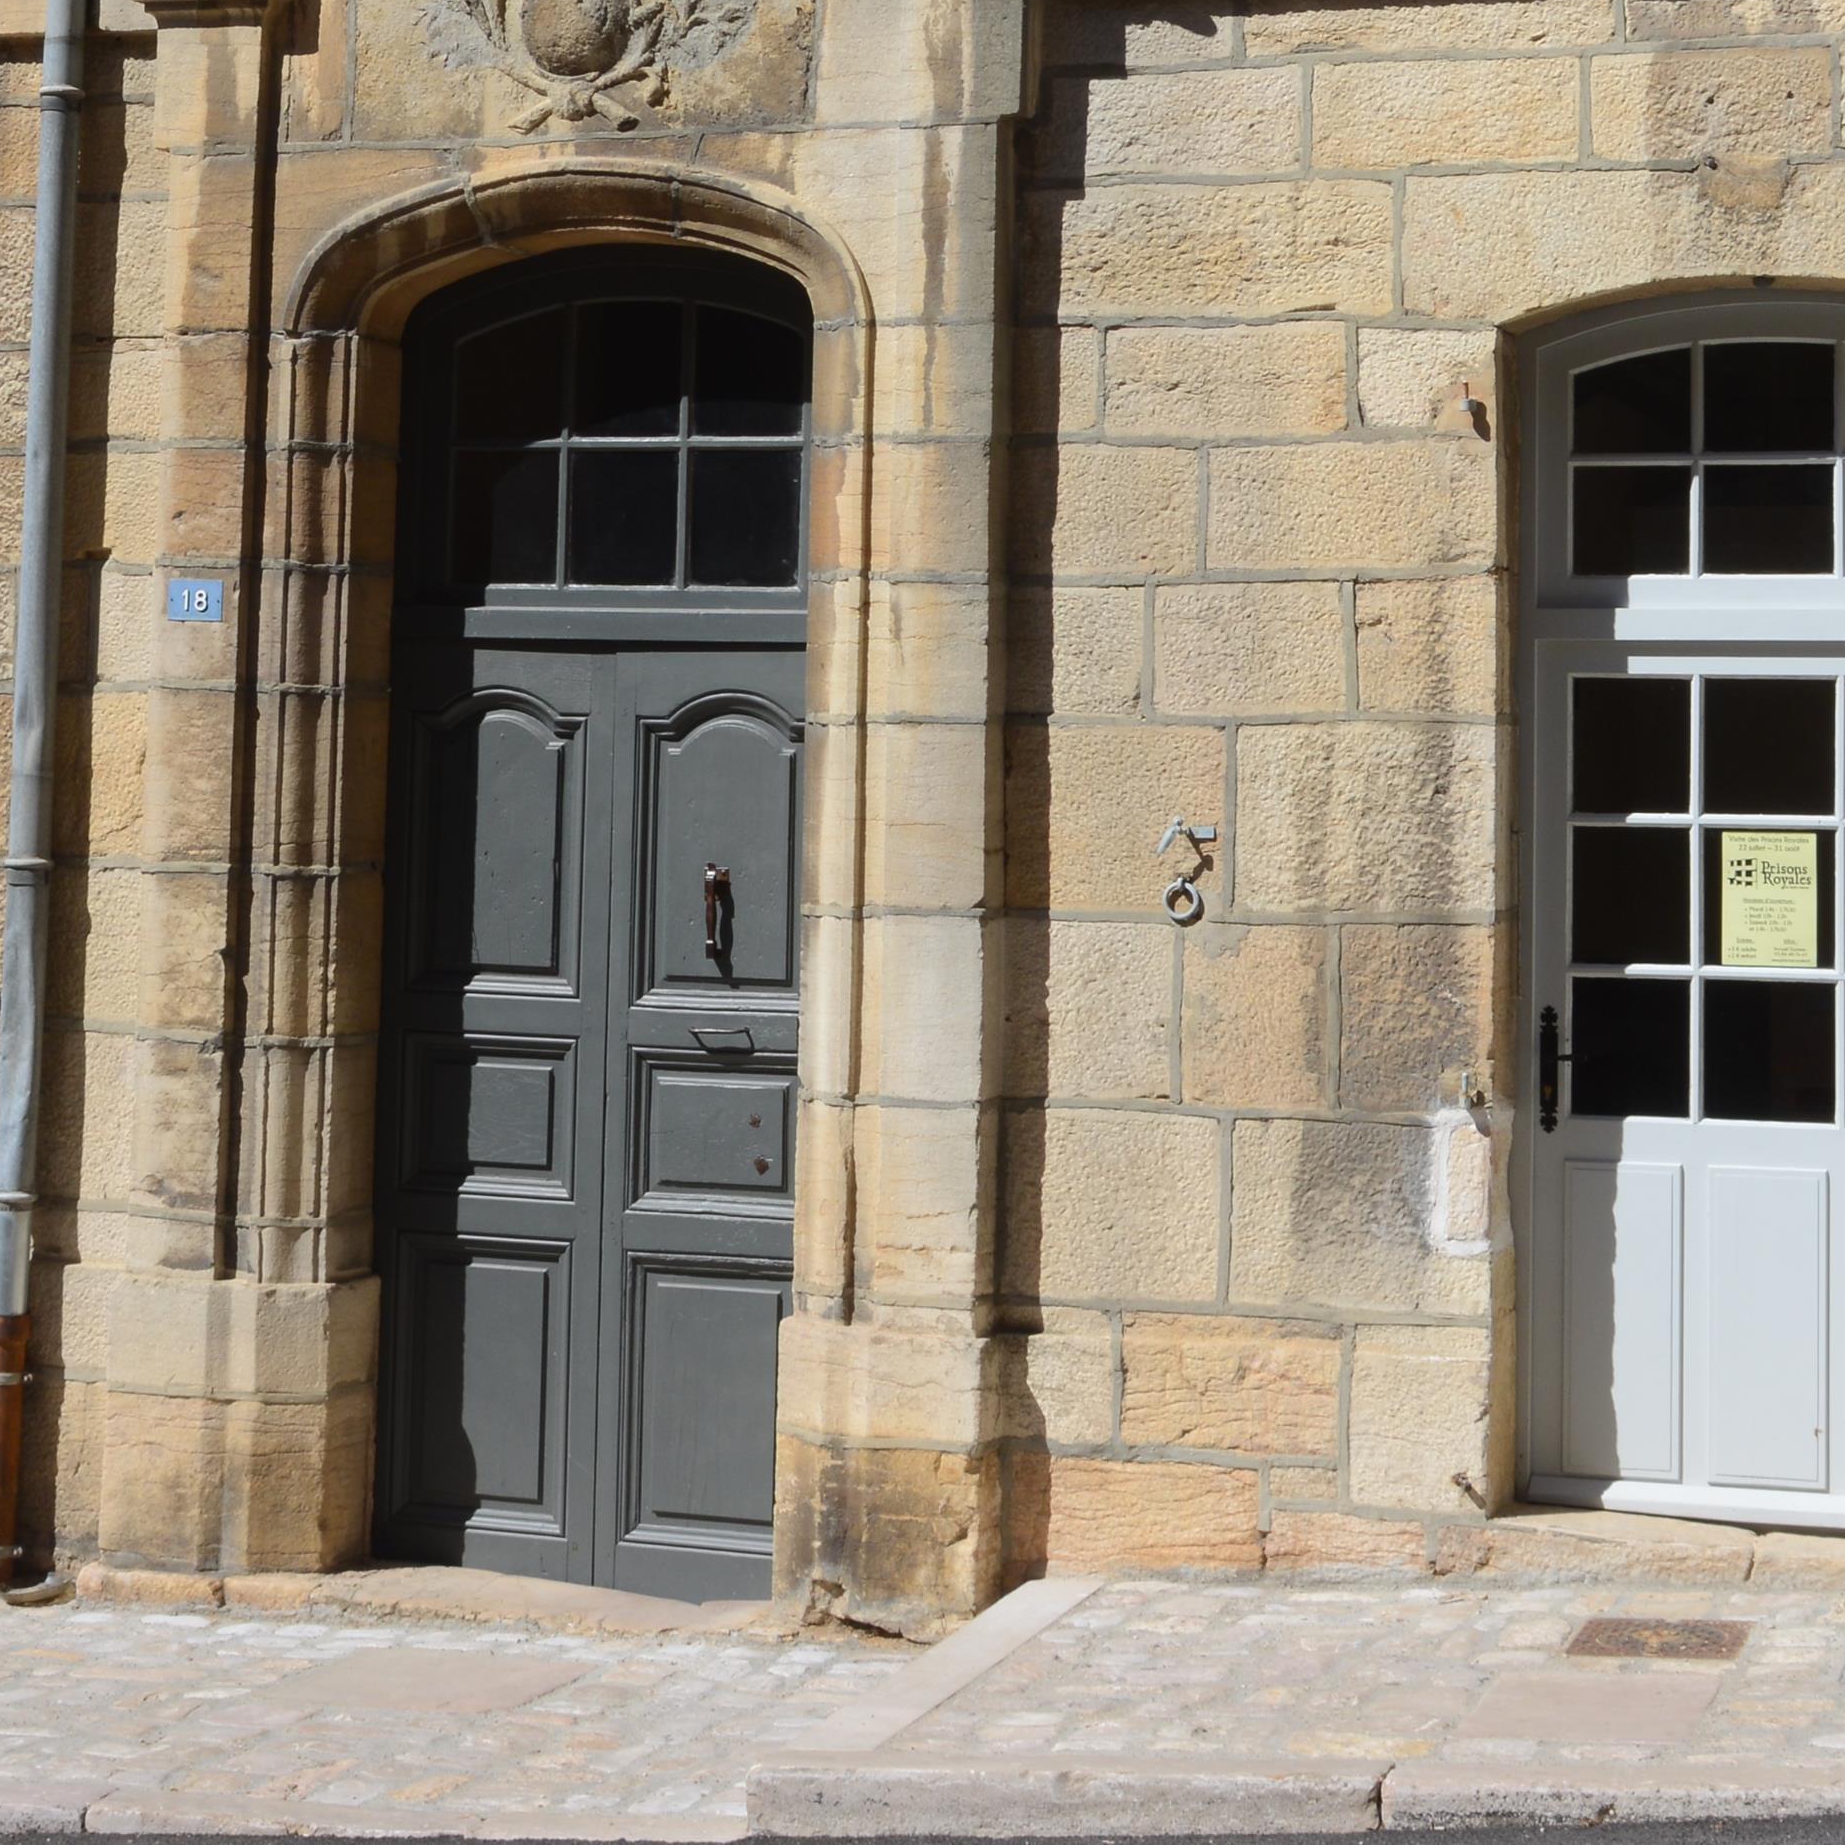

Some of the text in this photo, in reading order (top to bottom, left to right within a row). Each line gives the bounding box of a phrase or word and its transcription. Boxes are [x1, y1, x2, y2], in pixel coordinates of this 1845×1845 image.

[181, 588, 208, 612] 18
[1761, 860, 1808, 875] Prisons
[1762, 872, 1812, 890] Royales
